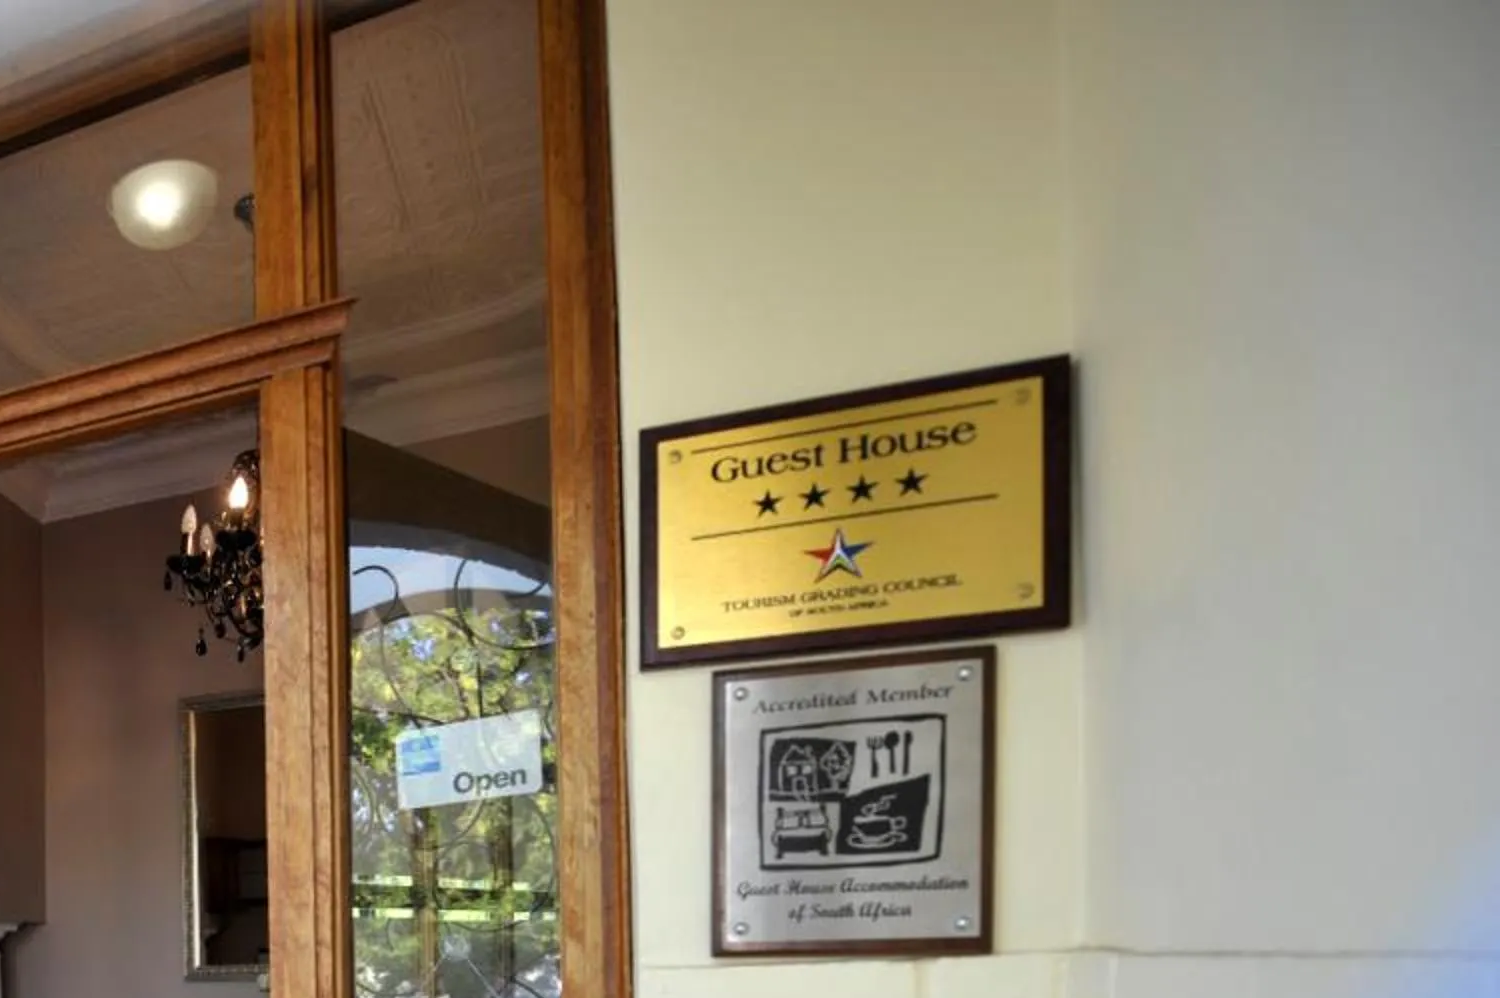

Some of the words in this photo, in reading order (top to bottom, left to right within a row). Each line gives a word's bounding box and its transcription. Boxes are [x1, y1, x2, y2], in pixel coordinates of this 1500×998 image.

[710, 442, 825, 484] Guest
[838, 420, 977, 465] House
[721, 593, 797, 613] TOURISM
[800, 585, 878, 604] GRADING
[882, 573, 962, 595] COUNCIL
[754, 690, 858, 714] Accredited
[866, 684, 954, 705] Member
[453, 768, 527, 795] Open
[736, 880, 780, 899] Guest
[785, 879, 835, 897] House
[840, 875, 969, 894] Accommodation
[788, 906, 804, 923] of
[810, 904, 855, 920] South
[858, 902, 913, 921] Africa
